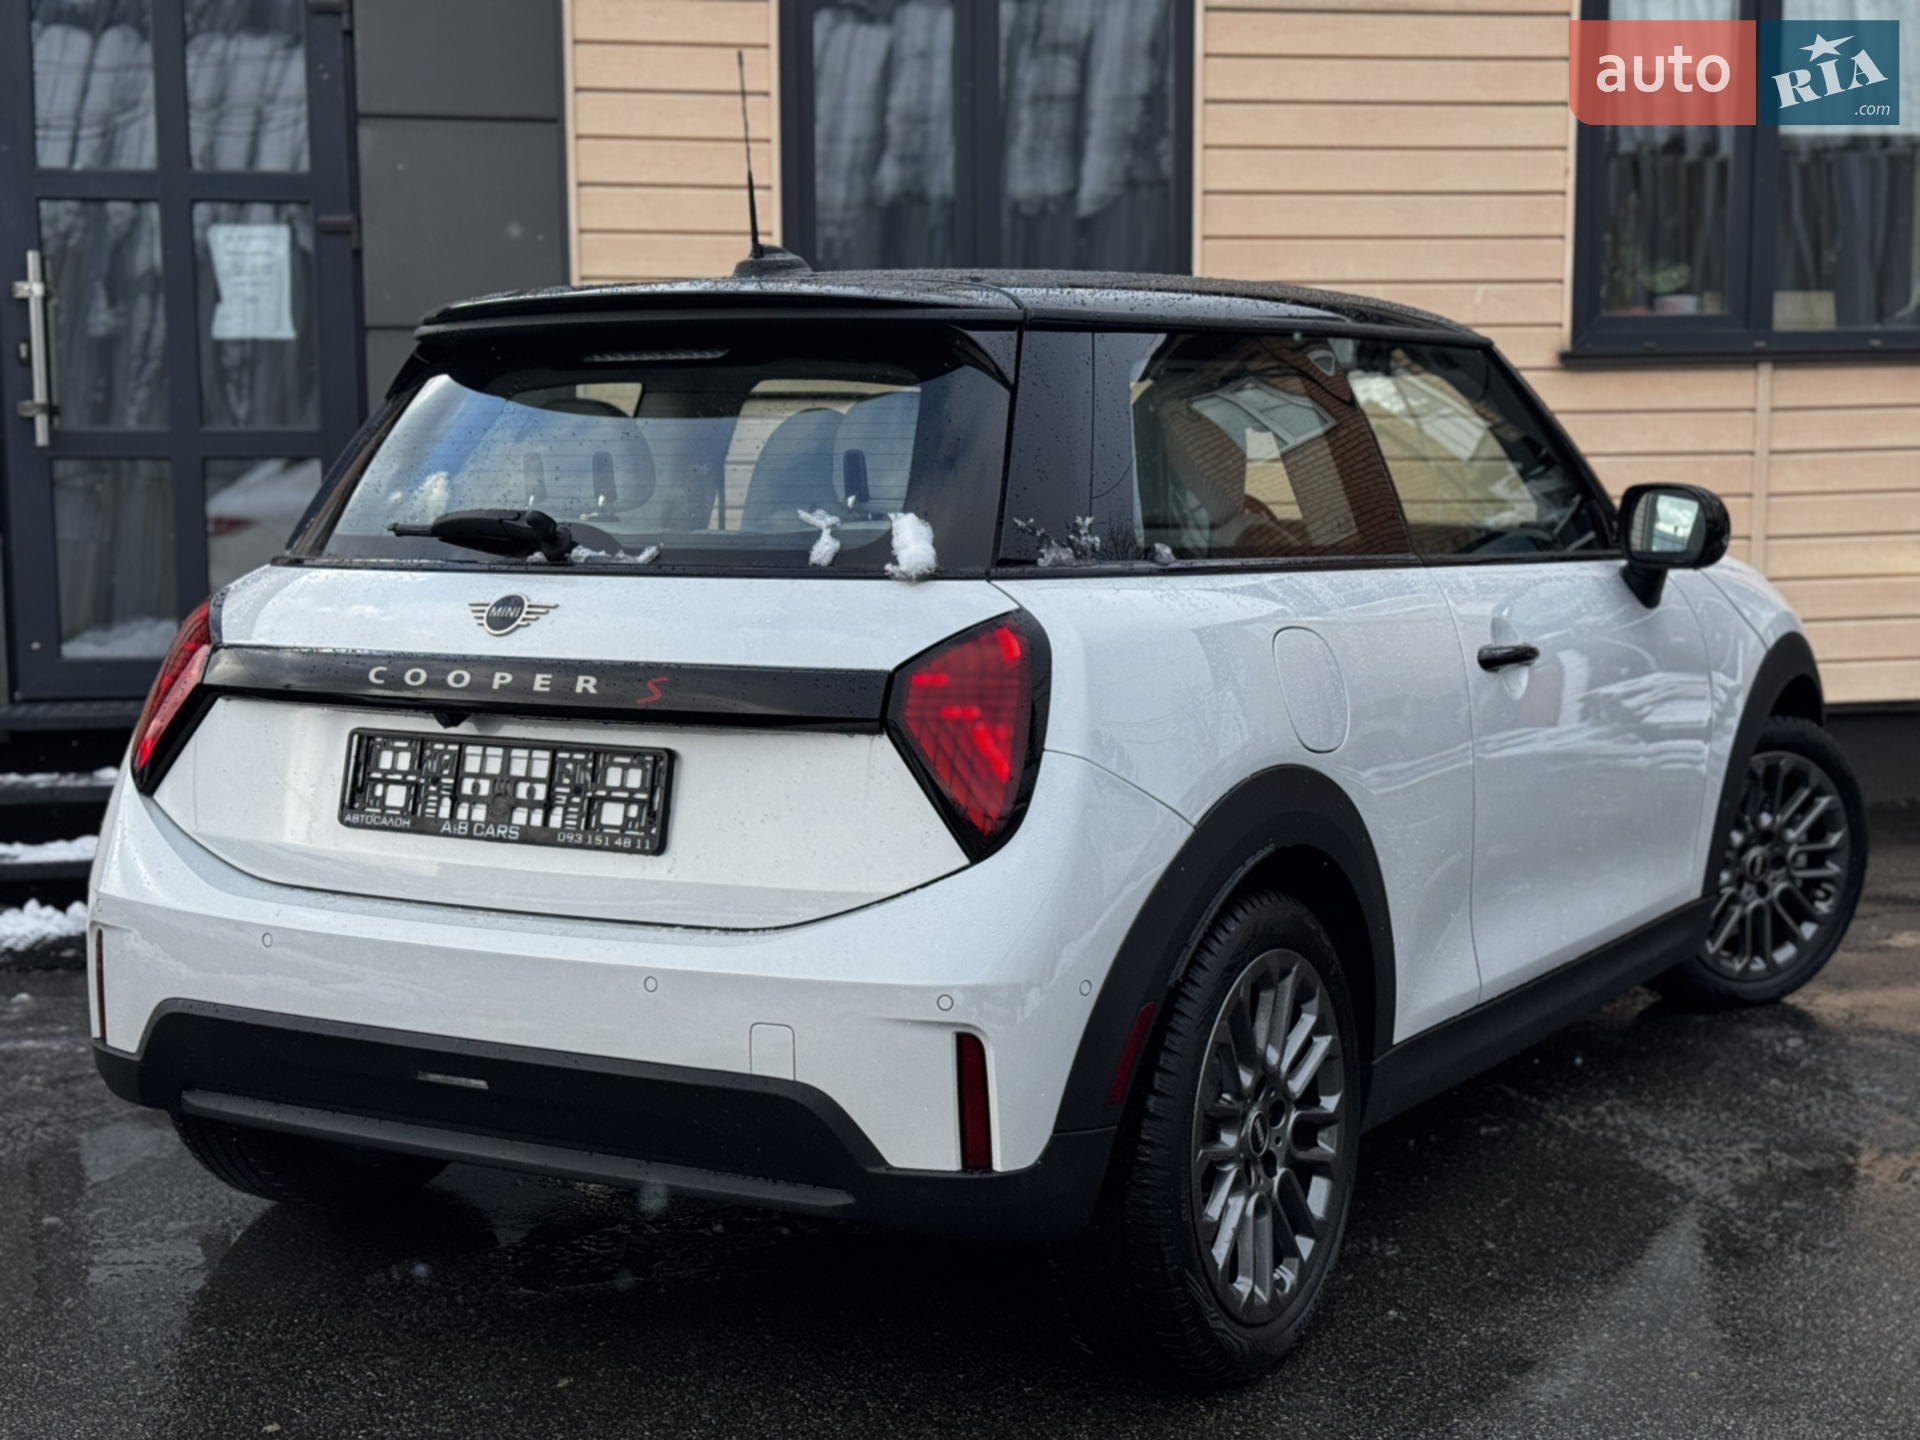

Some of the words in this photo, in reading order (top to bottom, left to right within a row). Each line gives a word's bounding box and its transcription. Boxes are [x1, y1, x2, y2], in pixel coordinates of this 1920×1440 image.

[489, 606, 522, 617] MINI
[368, 666, 599, 694] COOPER
[636, 676, 669, 705] S
[344, 813, 411, 828] АВТОСАЛОН
[473, 824, 520, 840] CARS
[557, 831, 582, 844] 093
[586, 835, 610, 846] 151
[614, 837, 632, 848] 48
[635, 839, 651, 850] 11
